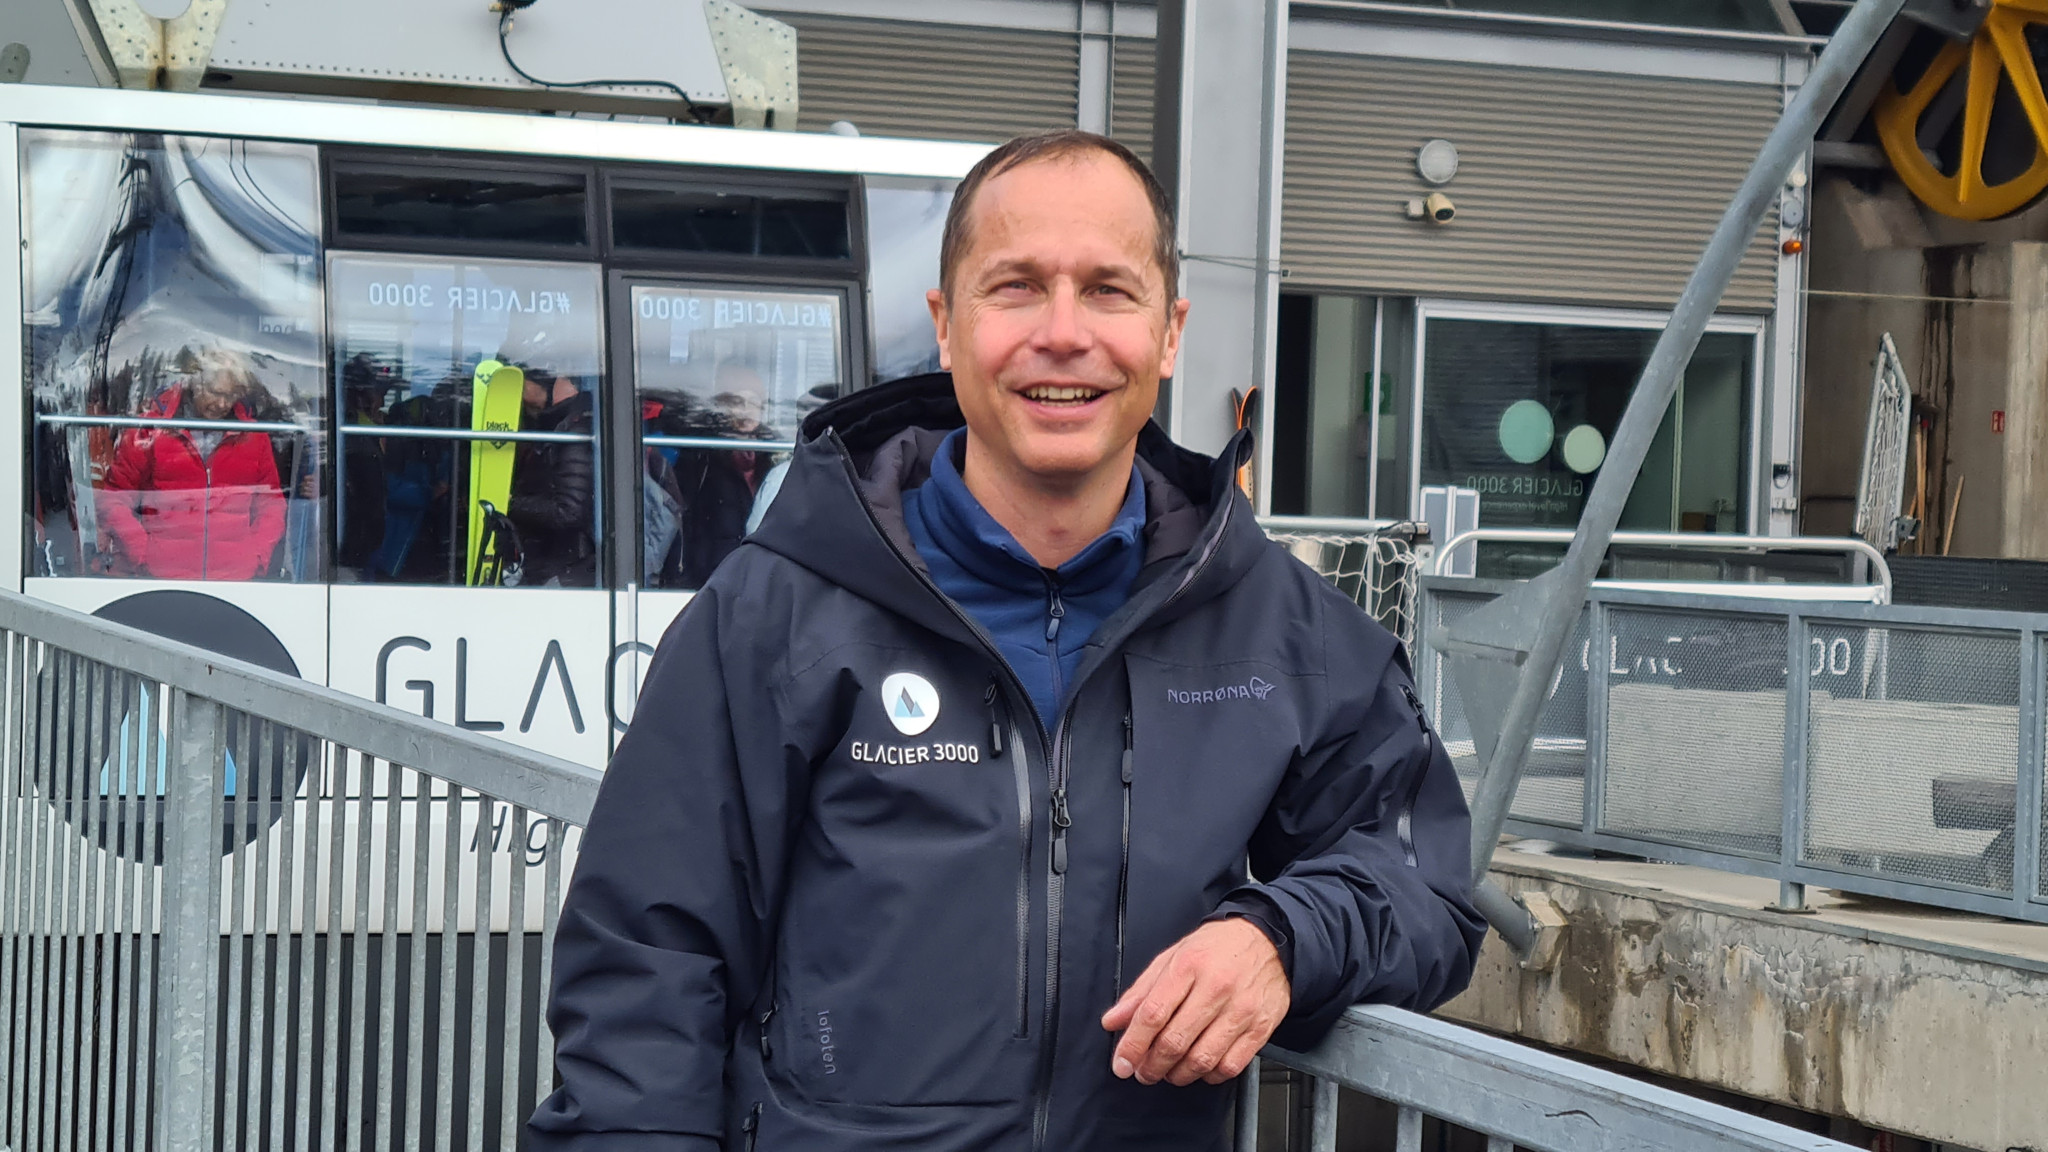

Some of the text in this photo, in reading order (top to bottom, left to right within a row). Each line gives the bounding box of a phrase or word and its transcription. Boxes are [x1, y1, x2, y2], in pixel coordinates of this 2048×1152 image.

[376, 636, 655, 734] GLAC
[1167, 685, 1251, 704] NORRØNA
[851, 742, 979, 765] GLACIER 3000
[817, 1010, 836, 1075] lofoten
